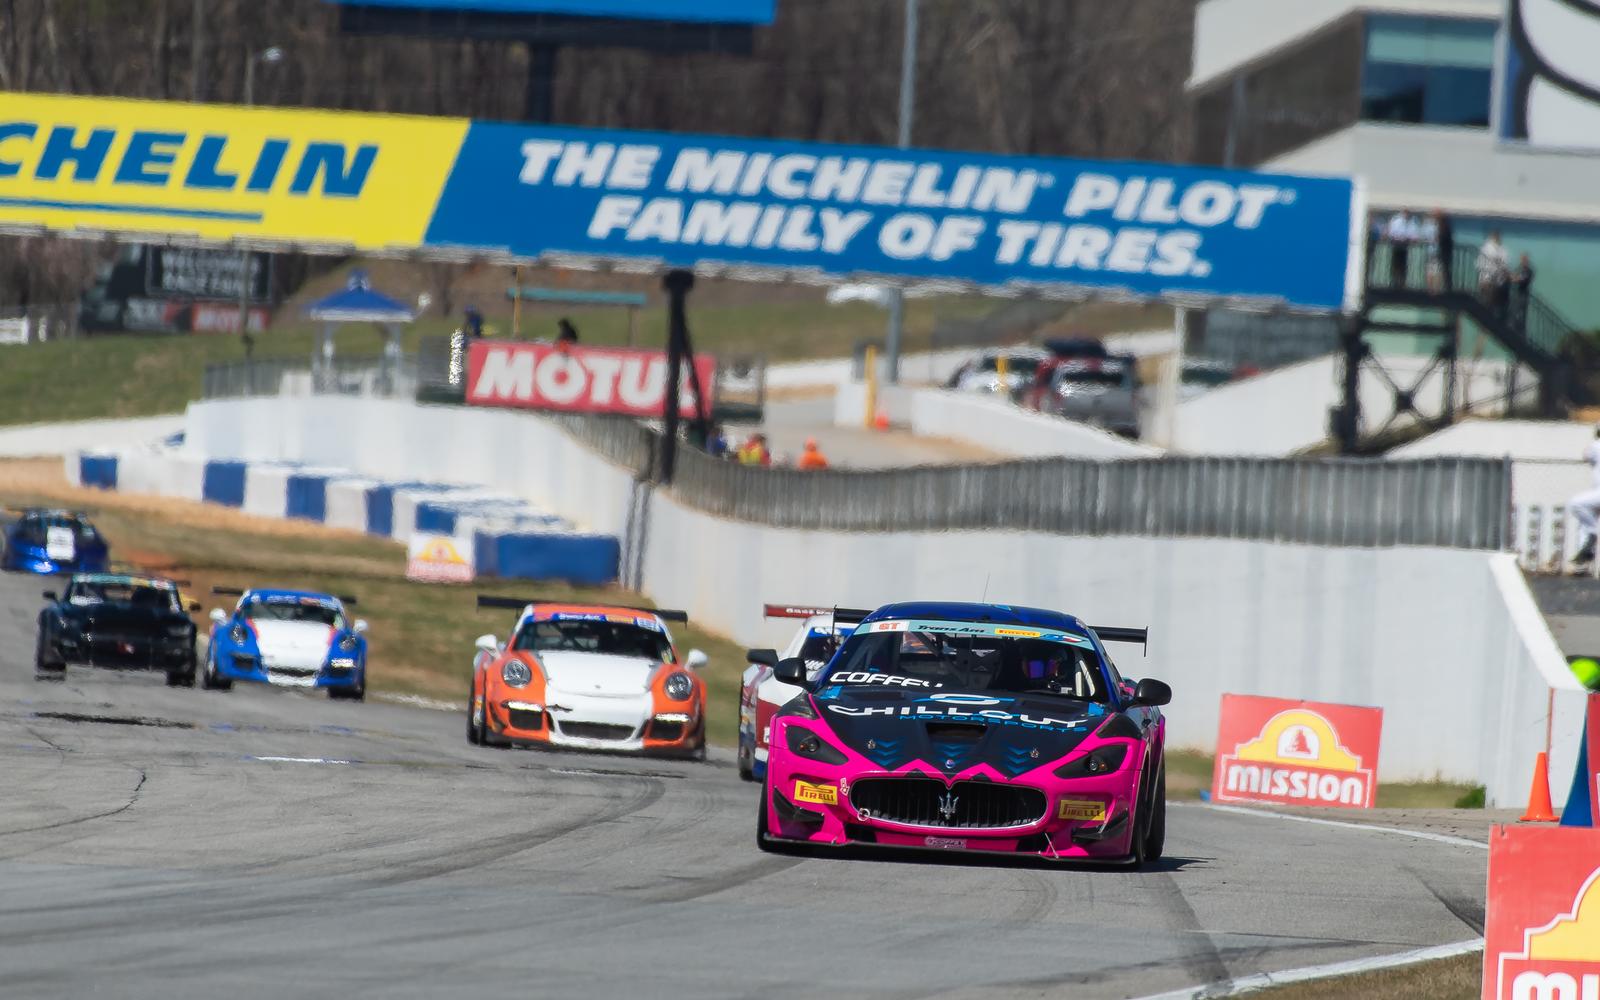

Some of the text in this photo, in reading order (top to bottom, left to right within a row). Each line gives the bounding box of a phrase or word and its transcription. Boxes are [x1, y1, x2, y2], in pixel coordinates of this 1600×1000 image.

[518, 139, 660, 190] THE
[587, 195, 1212, 278] FAMILY OF TIRES.
